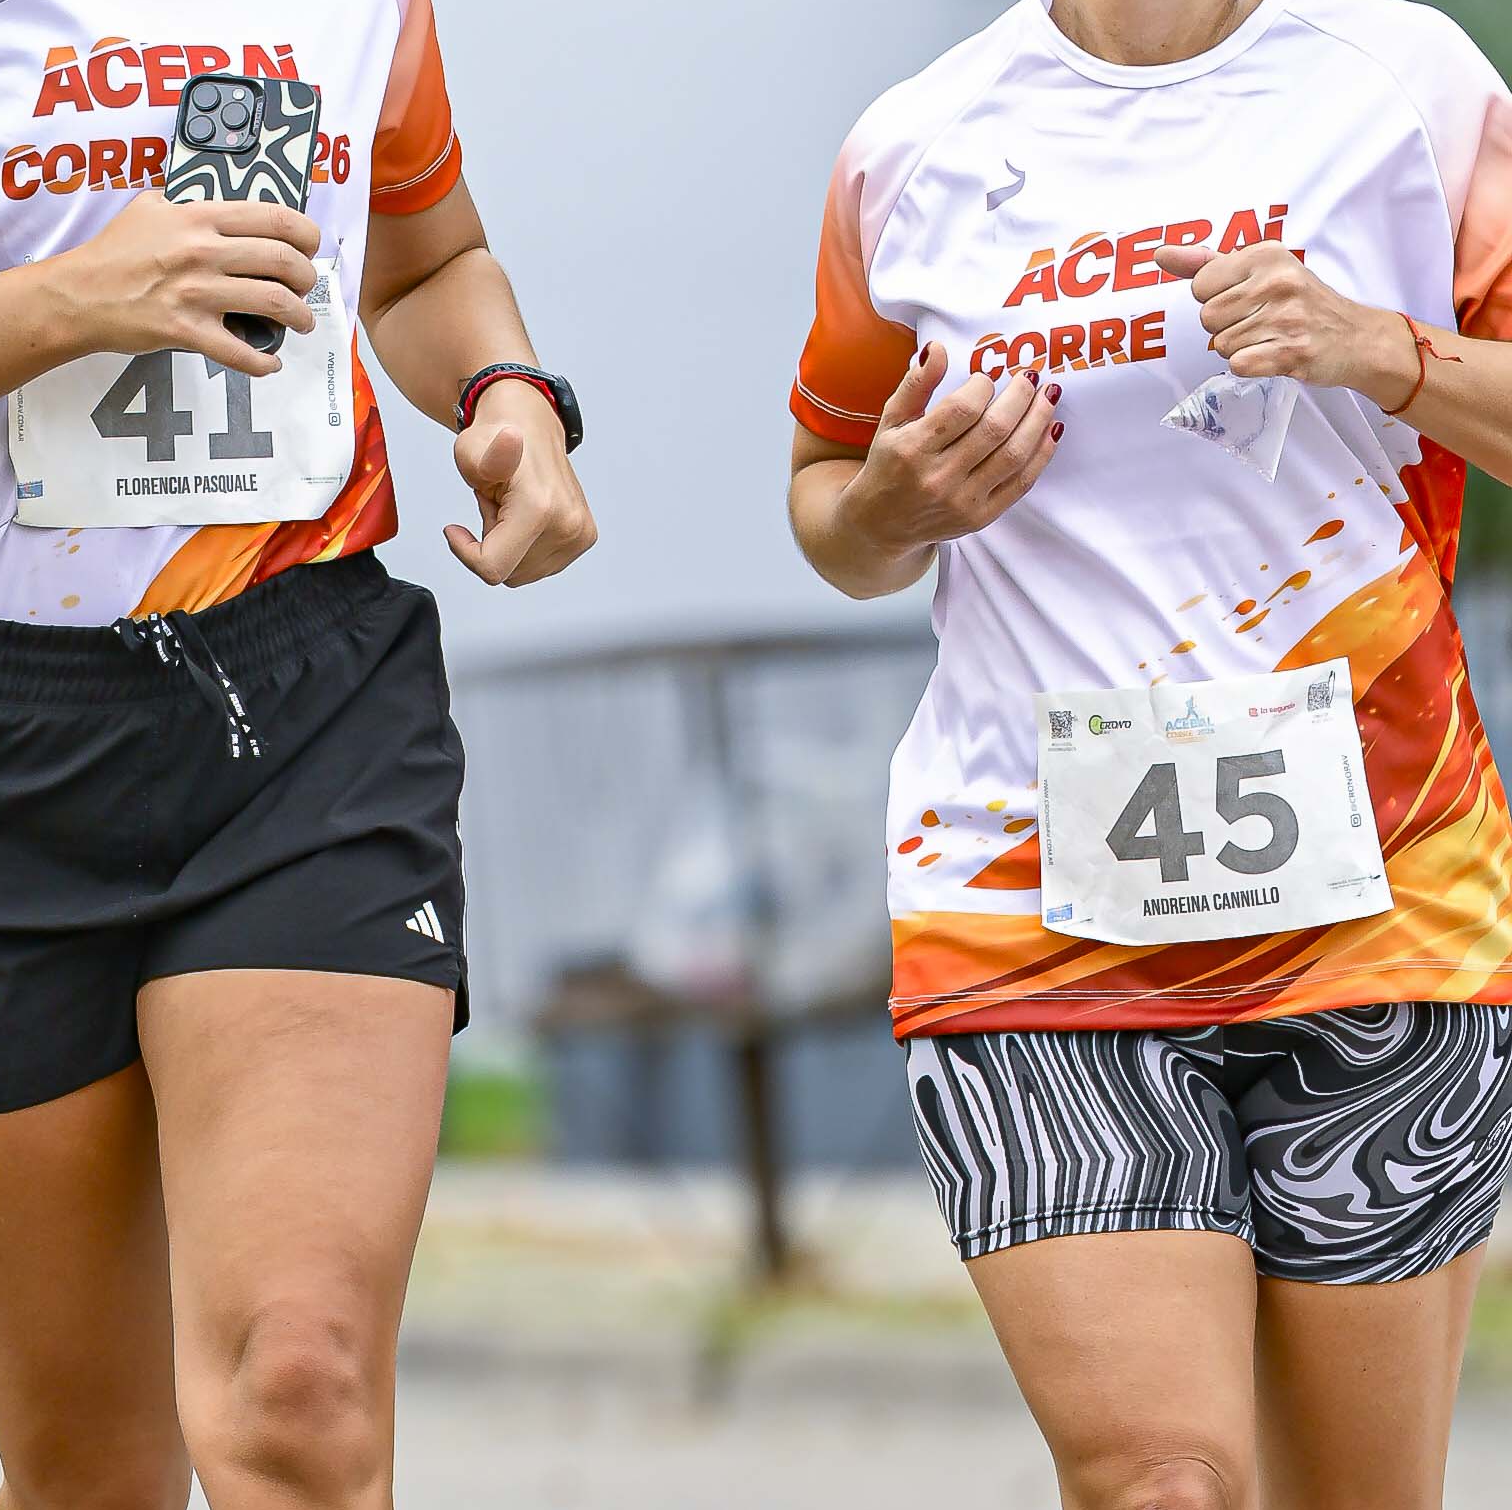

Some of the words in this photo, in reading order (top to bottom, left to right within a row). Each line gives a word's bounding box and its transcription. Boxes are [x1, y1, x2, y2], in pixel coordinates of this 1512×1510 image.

[1, 136, 169, 200] CORR
[310, 132, 350, 185] 26
[969, 309, 1167, 383] CORRE
[90, 350, 274, 462] 41
[327, 351, 336, 411] @CRONORAV
[116, 475, 191, 497] FLORENCIA
[194, 474, 258, 494] PASQUALE
[1105, 749, 1300, 883] 45
[1143, 898, 1211, 917] ANDREINA
[1213, 886, 1281, 909] CANNILLO
